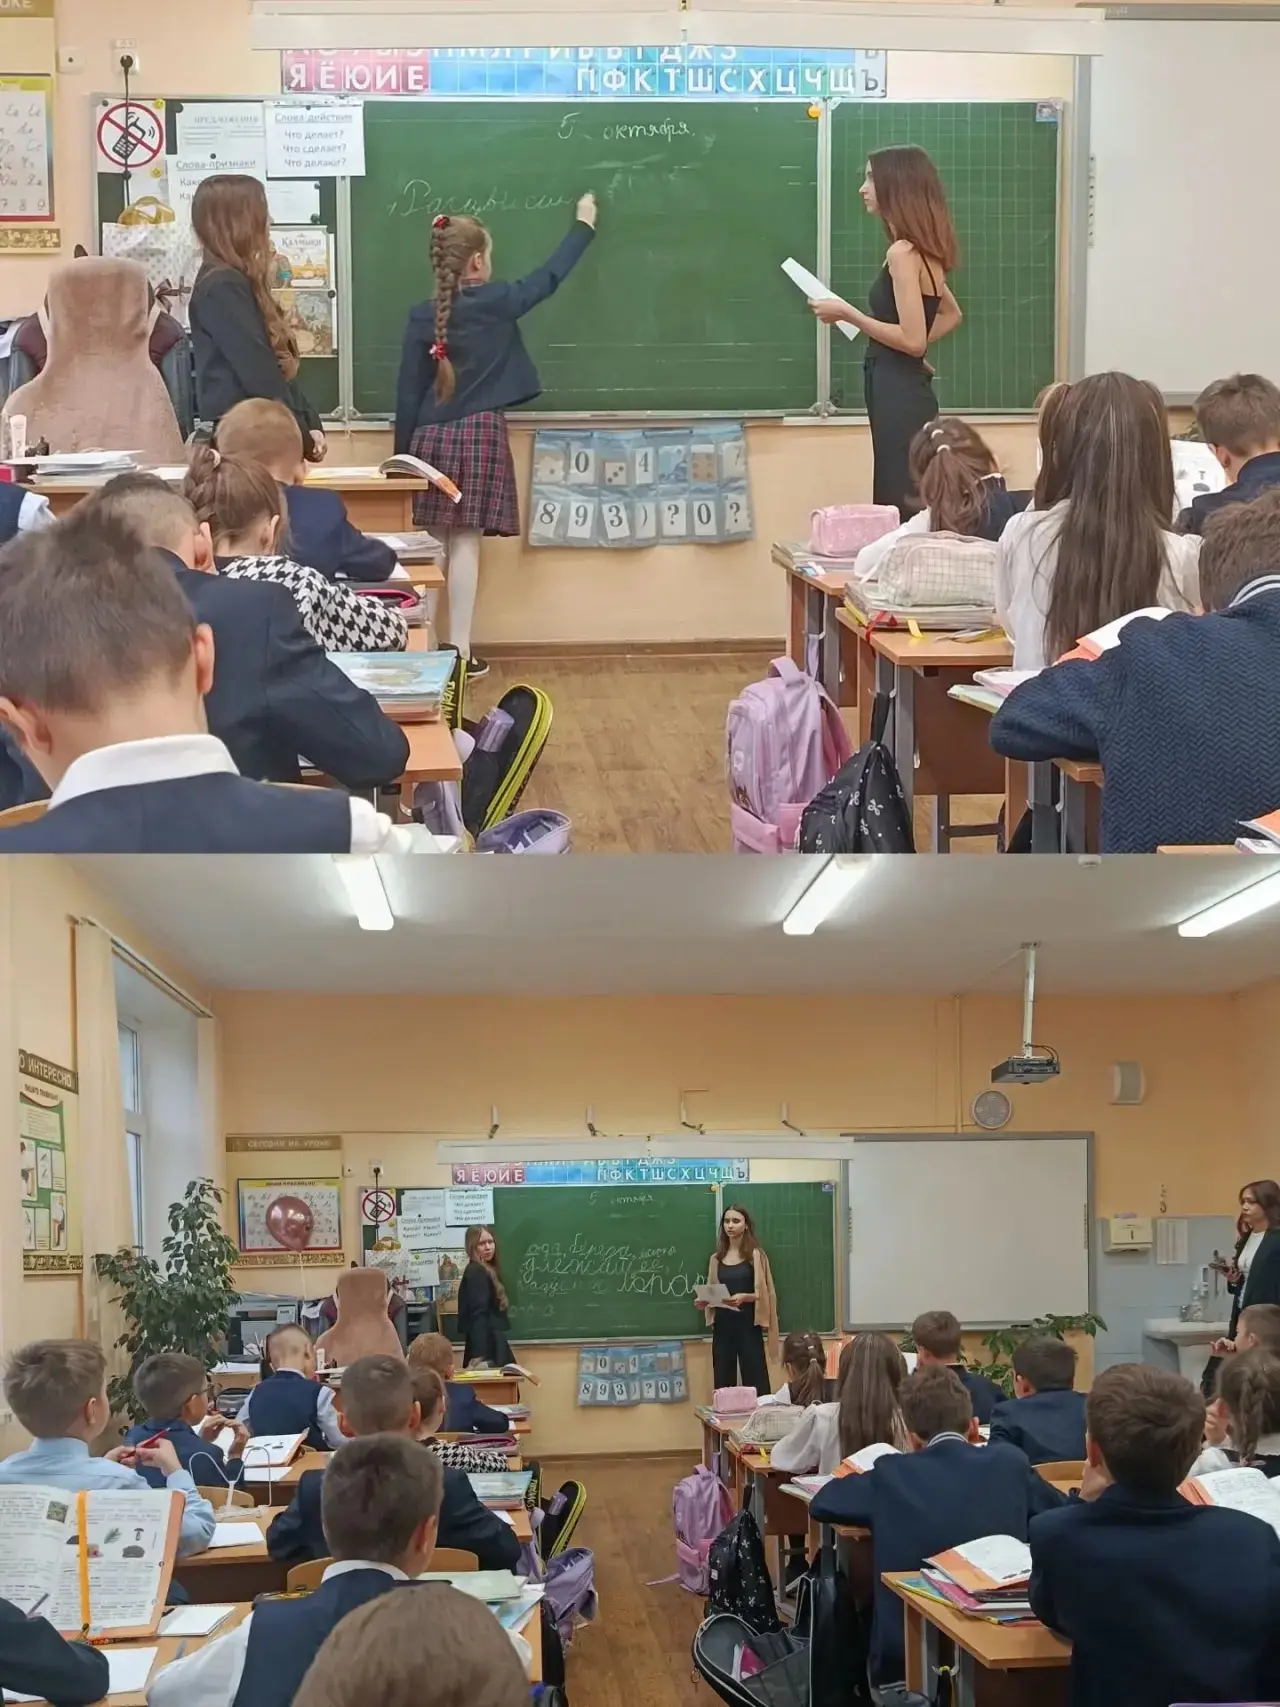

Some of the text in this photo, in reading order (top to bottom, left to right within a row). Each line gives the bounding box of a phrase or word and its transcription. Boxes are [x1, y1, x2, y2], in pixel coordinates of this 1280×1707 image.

[285, 131, 302, 139] Что
[283, 145, 300, 153] Что
[285, 159, 302, 167] Что
[575, 451, 590, 473] 0
[638, 452, 650, 473] 4
[539, 503, 556, 525] 8
[574, 504, 589, 527] 9
[608, 504, 624, 528] 3
[697, 503, 712, 525] 0
[29, 1058, 72, 1087] ИНТЕРЕСНО
[582, 1384, 591, 1395] 8
[600, 1383, 607, 1395] 9
[616, 1384, 624, 1396] 3
[660, 1382, 668, 1394] 0
